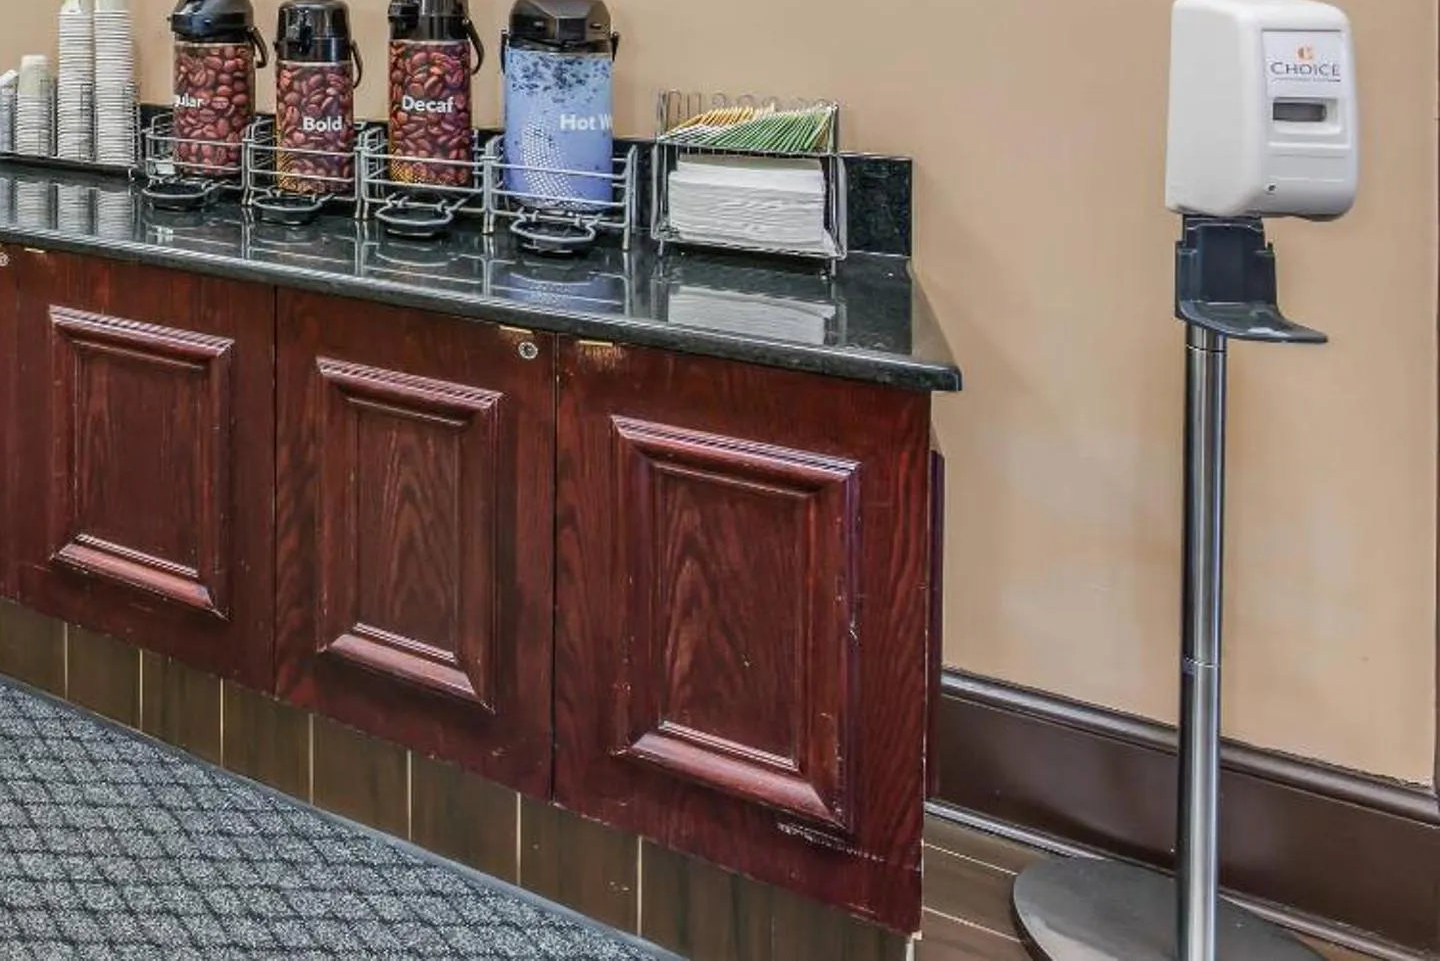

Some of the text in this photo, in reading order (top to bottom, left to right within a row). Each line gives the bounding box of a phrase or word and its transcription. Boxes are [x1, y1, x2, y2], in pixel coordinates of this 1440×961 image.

[1270, 62, 1341, 76] CHOICE
[402, 95, 454, 113] Decaf
[303, 116, 342, 132] Bold
[560, 114, 597, 130] Hot
